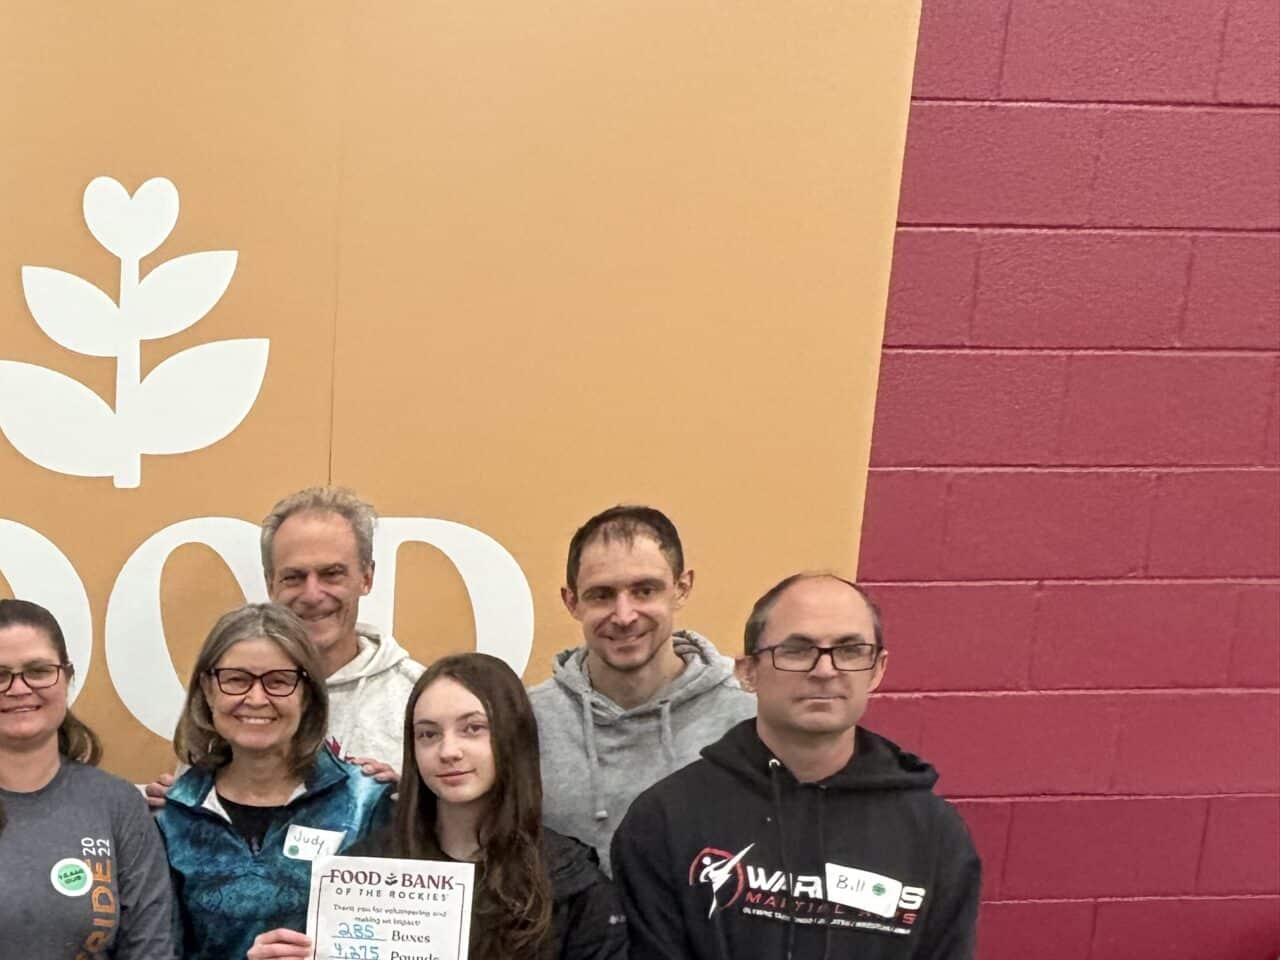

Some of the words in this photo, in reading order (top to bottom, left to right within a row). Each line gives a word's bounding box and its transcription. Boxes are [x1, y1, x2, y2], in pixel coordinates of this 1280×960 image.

[81, 837, 96, 856] 20
[96, 838, 111, 857] 22
[293, 831, 325, 855] Judy
[330, 869, 382, 886] FOOD
[401, 873, 454, 890] BANK
[335, 887, 351, 896] OF
[359, 889, 382, 898] THE
[389, 890, 447, 901] ROCKIES
[338, 922, 375, 939] 285
[391, 930, 431, 943] Boxes
